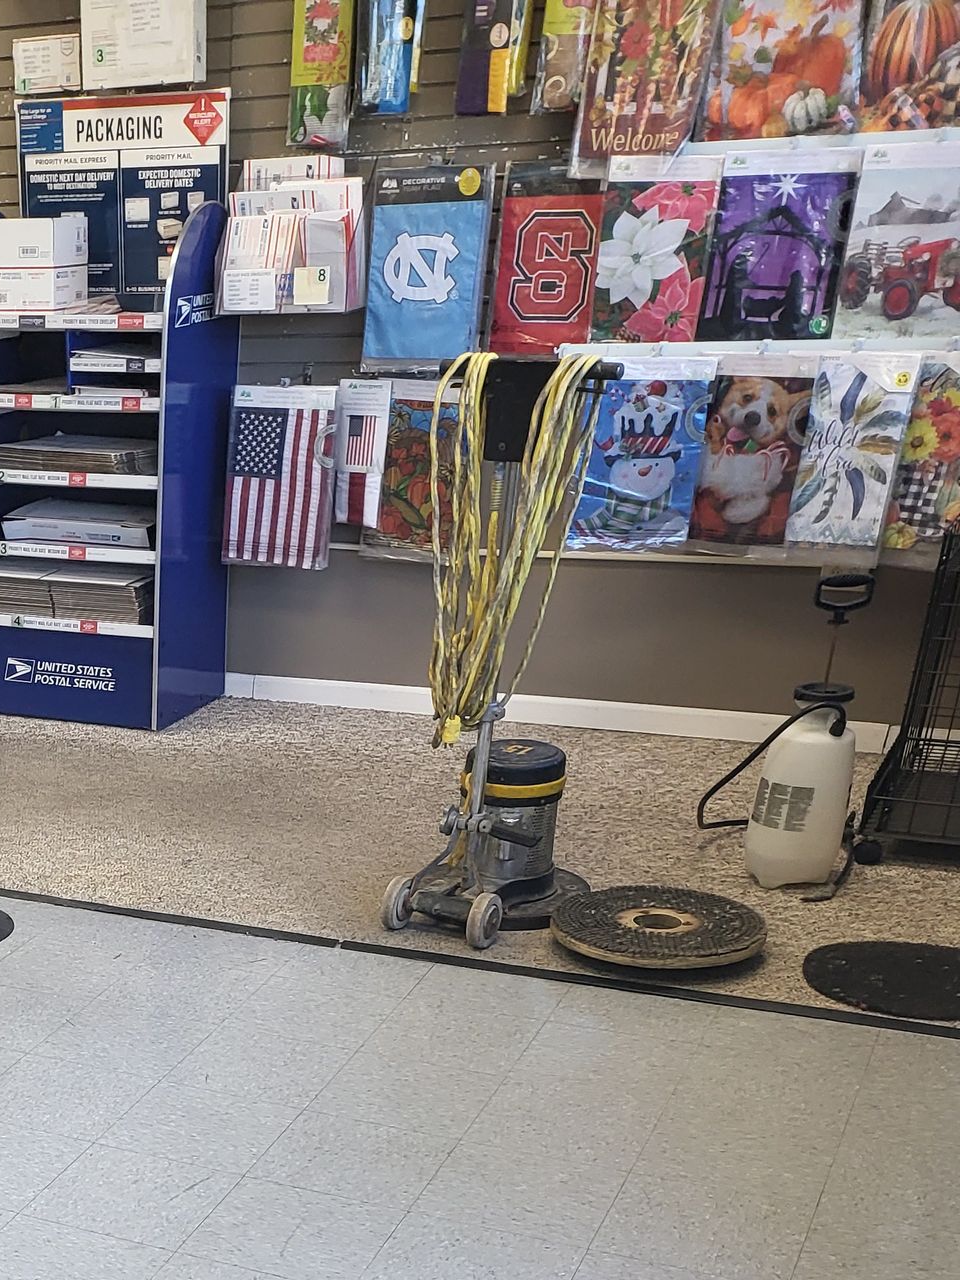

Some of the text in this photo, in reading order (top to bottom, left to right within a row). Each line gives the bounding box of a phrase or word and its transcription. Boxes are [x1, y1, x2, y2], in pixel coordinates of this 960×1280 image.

[96, 49, 104, 62] 3
[20, 79, 26, 91] 1
[76, 116, 163, 143] PACKAGING
[590, 127, 679, 152] Welcome
[146, 152, 192, 161] PRIORITY MAIL
[30, 171, 114, 183] DOMESTIC NEXT DAY DELIVERY
[138, 168, 201, 179] EXPECTED DOMESTIC
[145, 178, 193, 188] DELIVERY DATES
[402, 177, 446, 186] DECORATIVE
[318, 269, 326, 281] 8
[808, 419, 859, 453] Wild
[0, 543, 7, 554] 3
[13, 615, 20, 626] 4
[36, 661, 112, 677] UNITED STATES
[34, 674, 116, 691] POSTAL SERVICE
